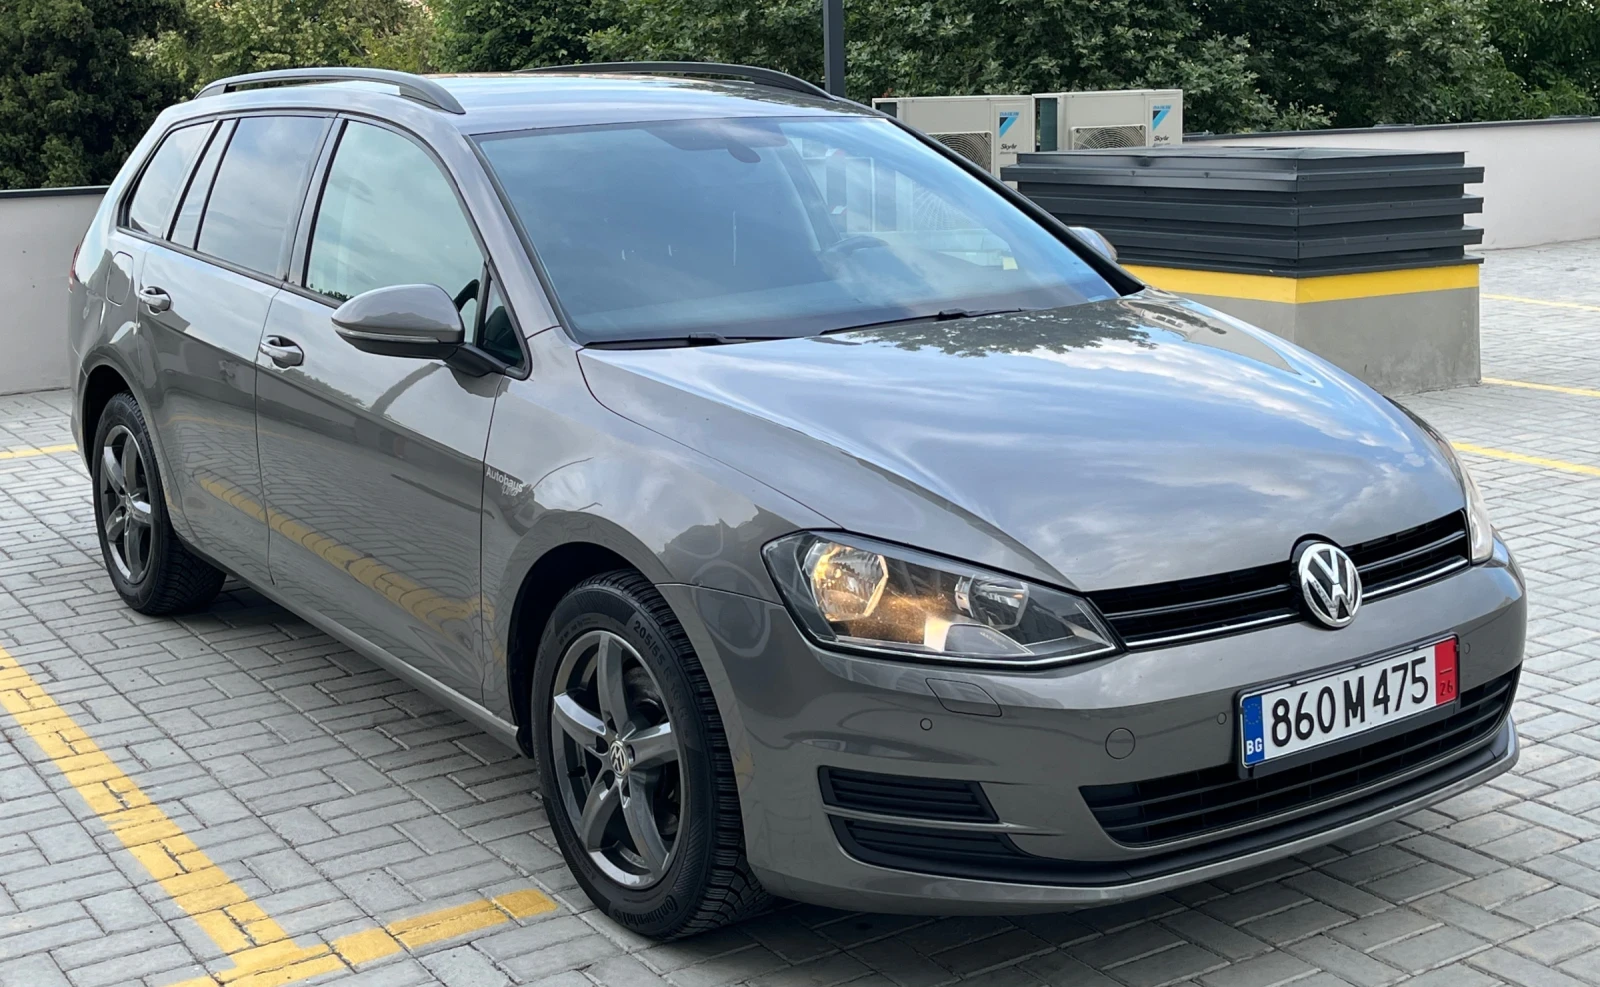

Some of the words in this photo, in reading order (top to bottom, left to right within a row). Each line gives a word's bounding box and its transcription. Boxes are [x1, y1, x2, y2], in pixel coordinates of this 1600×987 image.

[485, 466, 524, 493] Autohaus
[633, 620, 666, 667] 205/55
[1246, 737, 1263, 756] BG
[1440, 679, 1454, 696] 26
